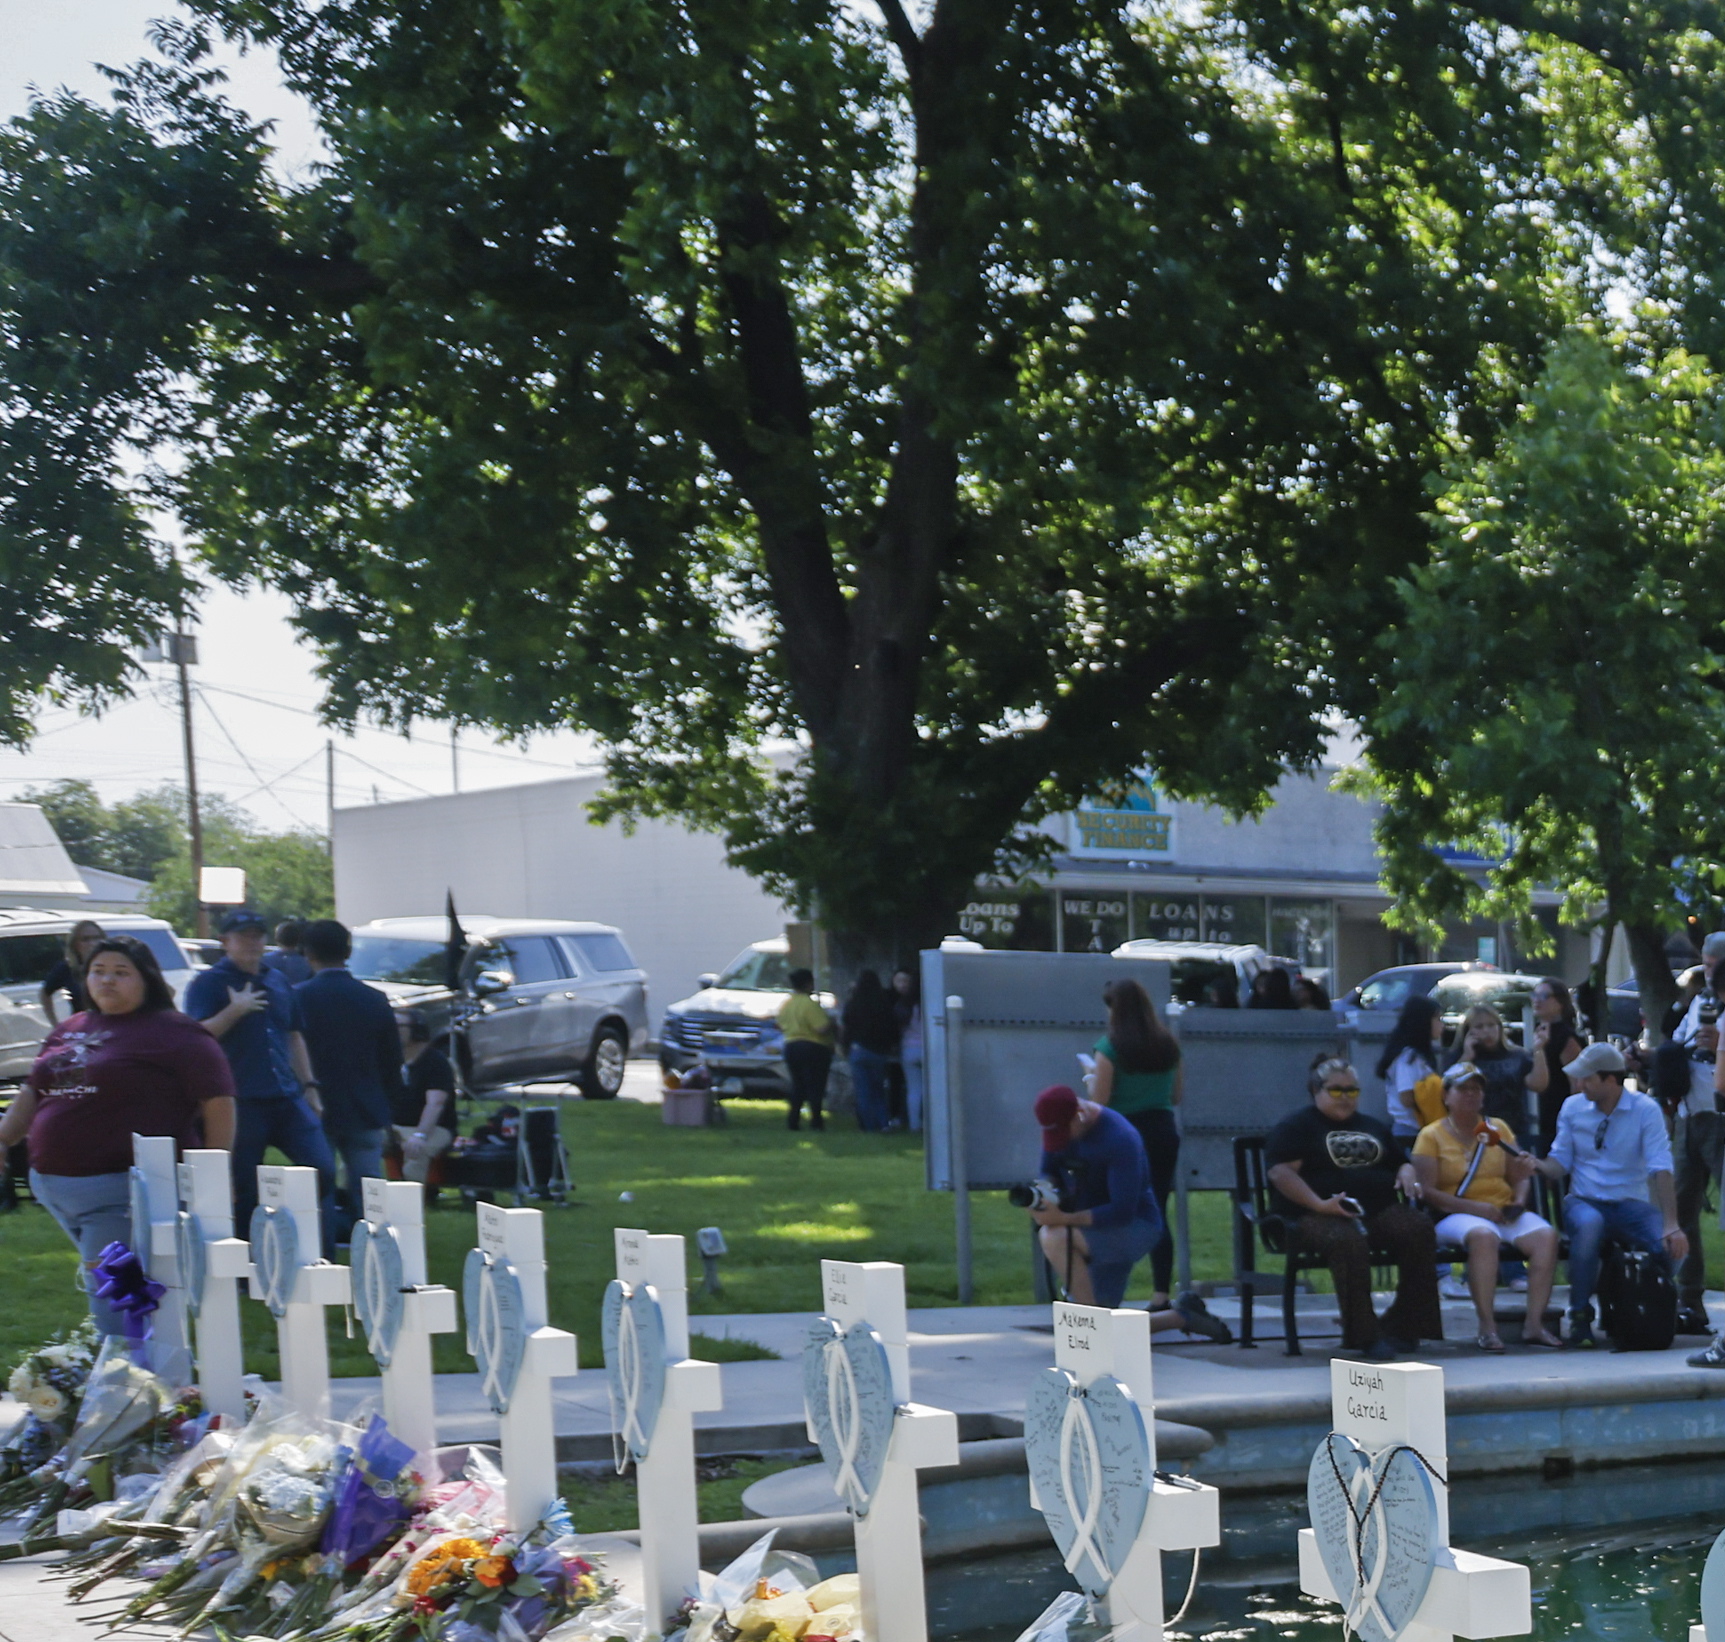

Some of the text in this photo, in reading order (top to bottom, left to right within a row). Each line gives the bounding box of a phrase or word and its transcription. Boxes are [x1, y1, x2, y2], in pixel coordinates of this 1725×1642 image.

[1076, 811, 1172, 832] SECURITY
[1081, 829, 1168, 850] FINANCE
[1064, 901, 1125, 916] WE DO
[1149, 904, 1233, 920] LOANS
[960, 918, 985, 935] Up
[1068, 1335, 1091, 1351] Elrod
[1349, 1368, 1384, 1394] Uziyah
[1347, 1397, 1388, 1421] Garcia
